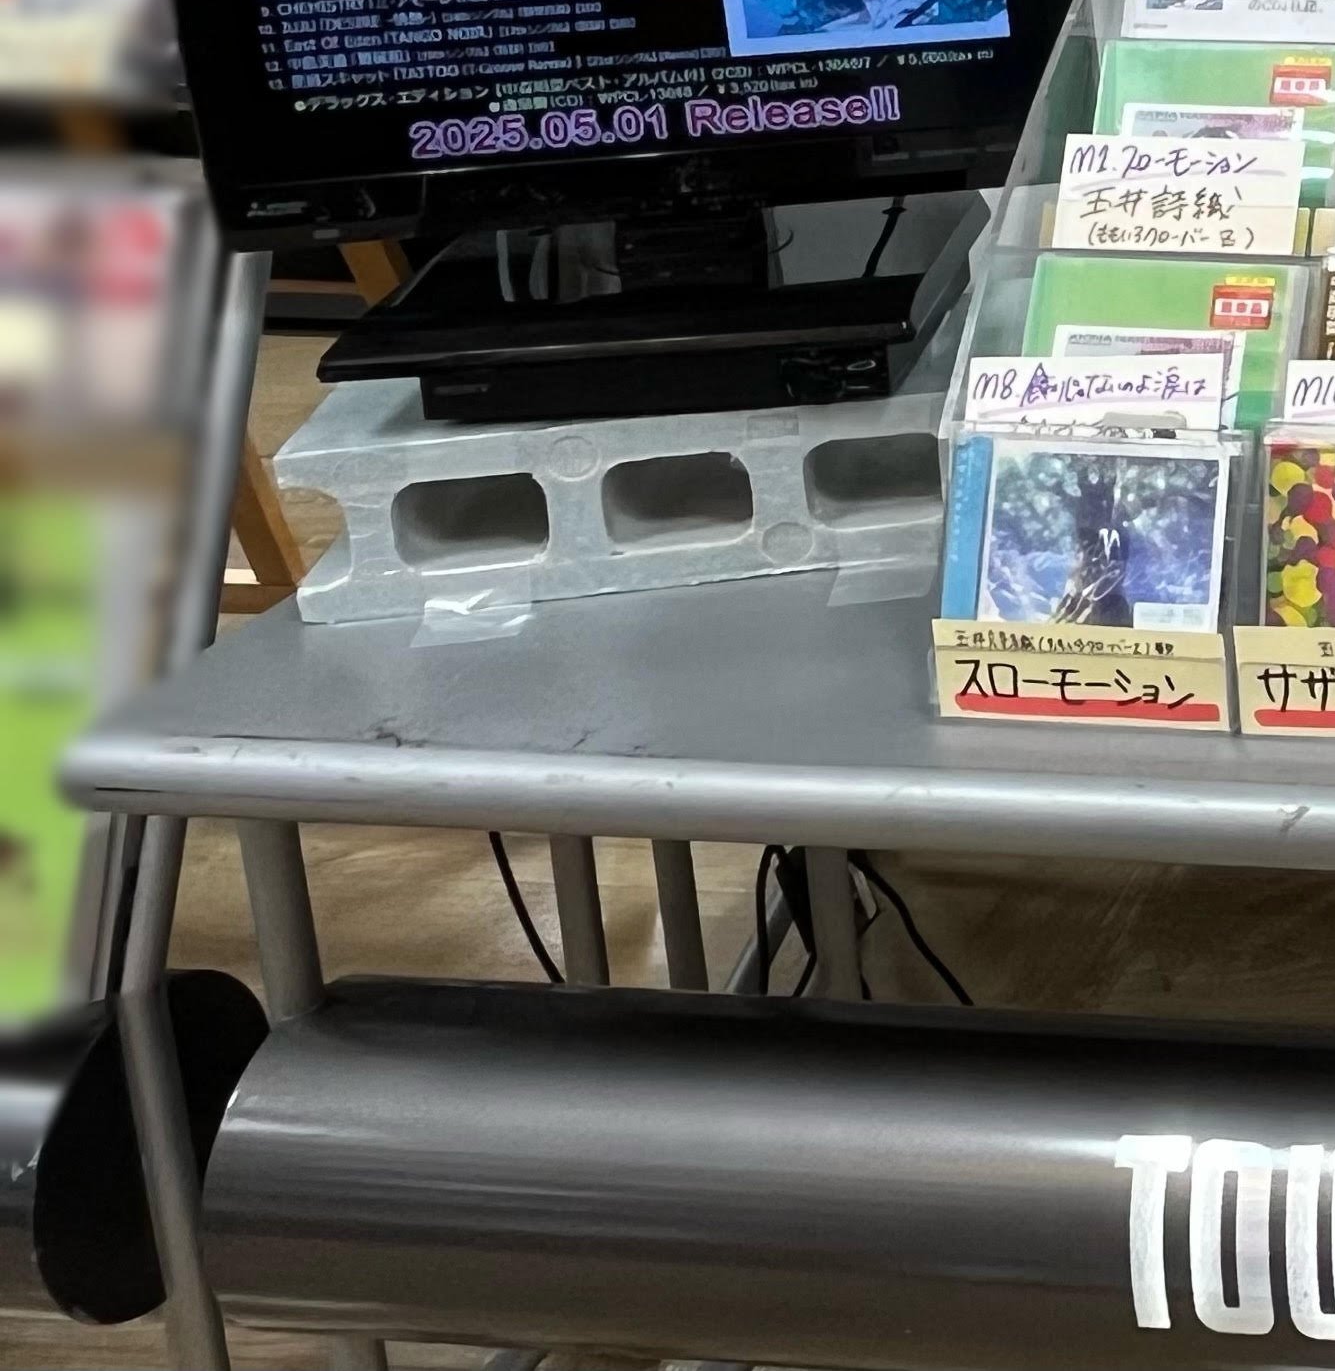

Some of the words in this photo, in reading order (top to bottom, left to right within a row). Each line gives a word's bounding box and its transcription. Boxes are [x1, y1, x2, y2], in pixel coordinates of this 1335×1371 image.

[409, 104, 668, 160] 2025.05.01
[954, 659, 1195, 709] スローモーション
